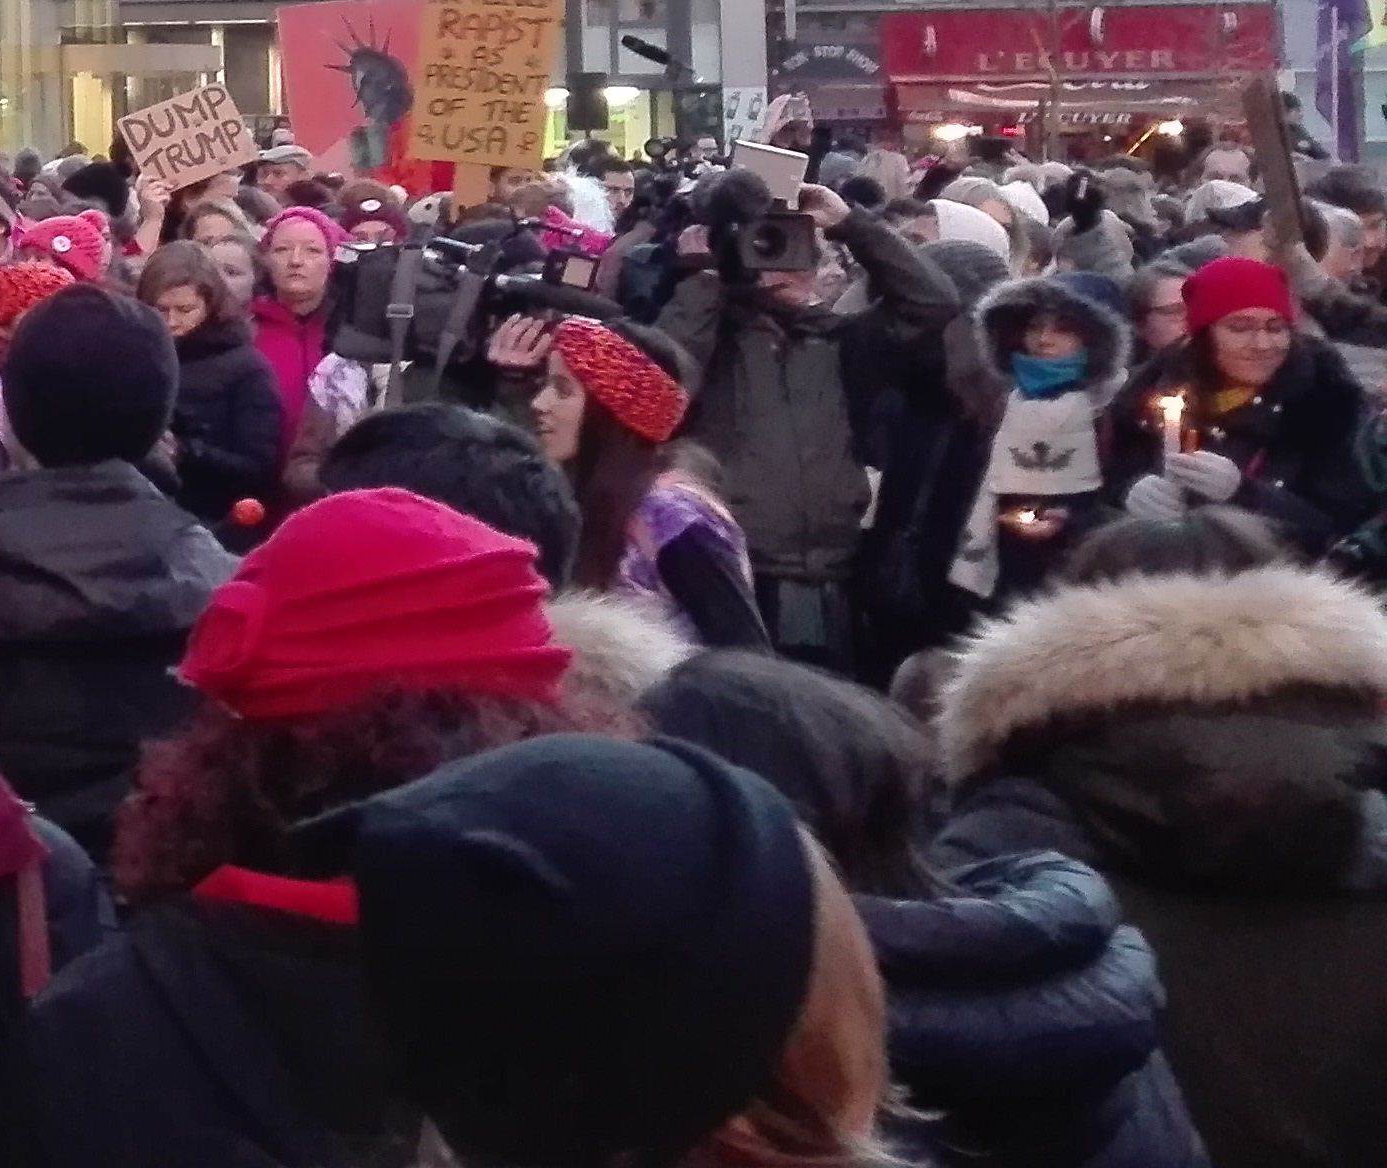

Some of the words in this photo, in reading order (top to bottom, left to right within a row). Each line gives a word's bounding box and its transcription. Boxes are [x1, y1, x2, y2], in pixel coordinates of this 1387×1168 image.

[122, 87, 226, 152] DUMP
[428, 97, 467, 117] OF
[482, 98, 536, 124] THE
[142, 119, 242, 179] TRUMP
[441, 124, 509, 155] USA
